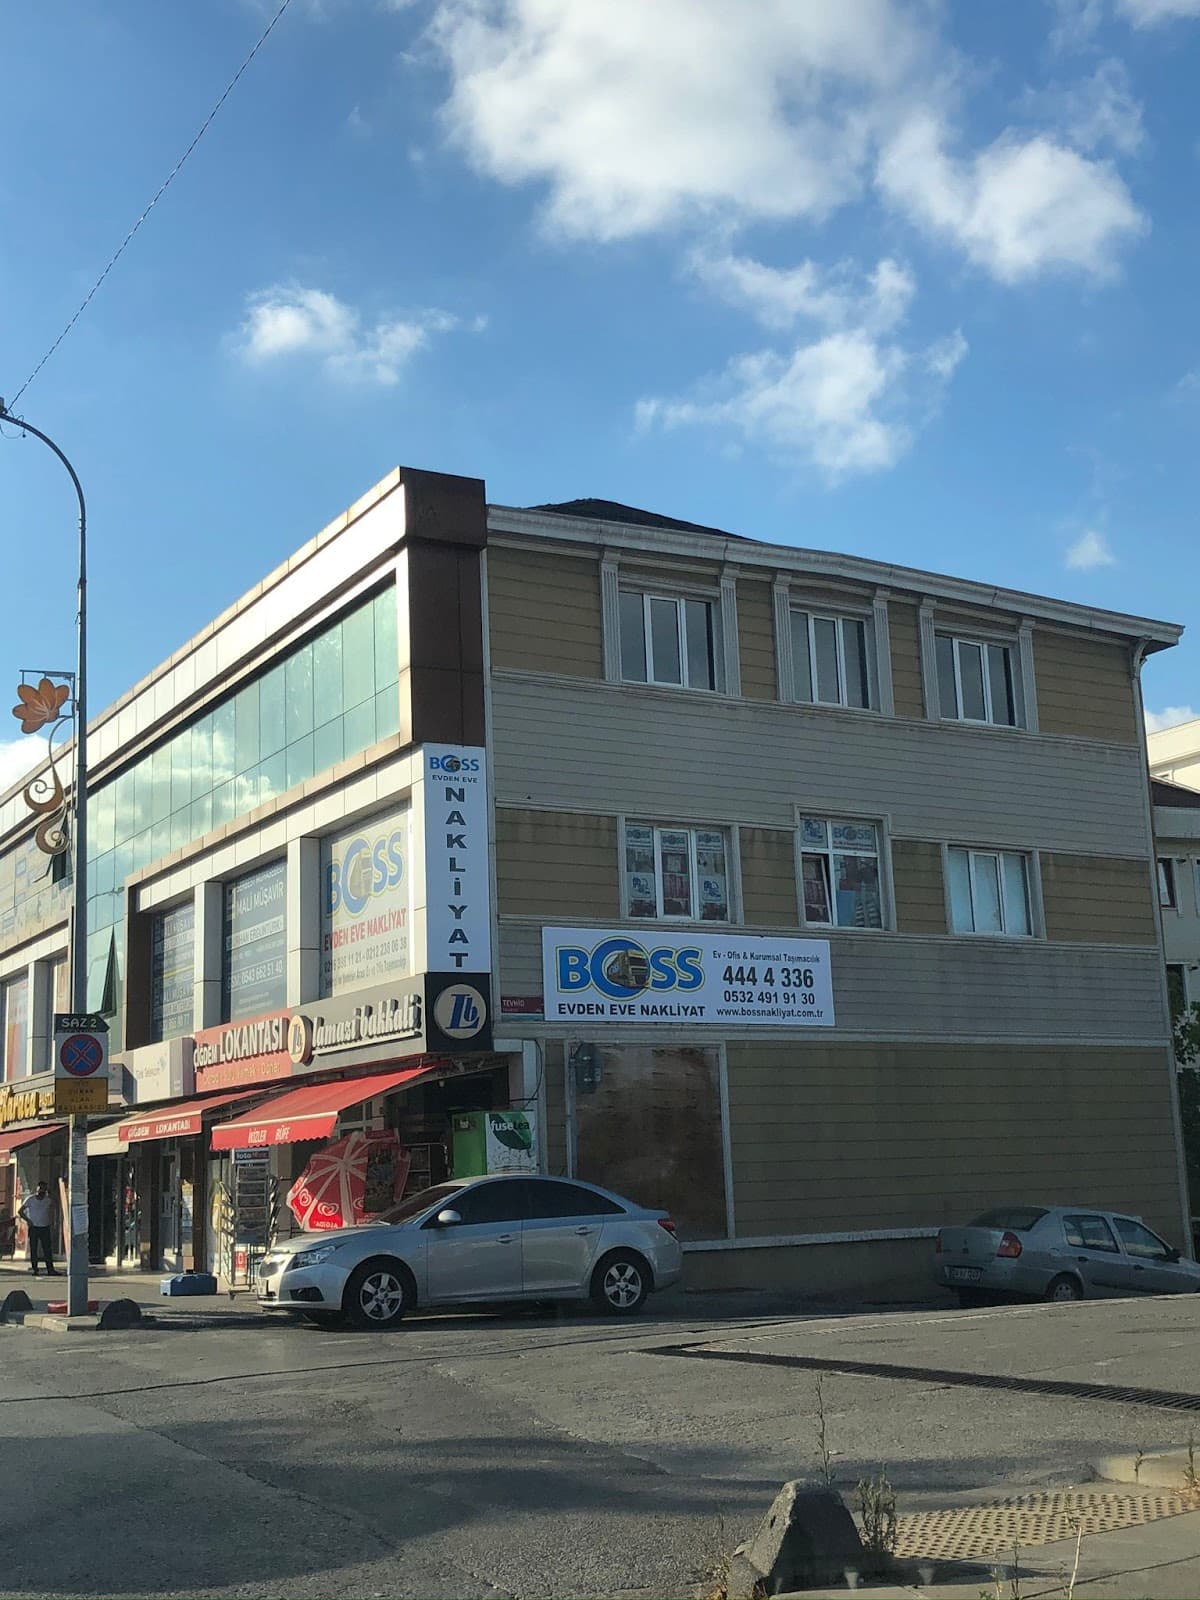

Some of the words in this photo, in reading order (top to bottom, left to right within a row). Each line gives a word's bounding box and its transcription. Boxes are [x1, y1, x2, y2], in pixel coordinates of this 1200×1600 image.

[429, 755, 480, 773] BOSS
[326, 830, 404, 916] BOSS
[445, 786, 470, 968] NAKLİYAT
[324, 927, 348, 952] EVDEN
[350, 921, 366, 943] EVE
[367, 907, 407, 937] NAKLİYAT
[713, 950, 721, 959] Ev
[727, 951, 741, 960] Ofis
[750, 952, 782, 962] Kurumsal
[783, 953, 820, 963] Taşımacılık
[556, 937, 705, 1000] BOSS
[722, 965, 758, 986] 444
[763, 967, 775, 987] 4
[781, 967, 814, 989] 336
[724, 990, 754, 1003] 0532
[758, 991, 778, 1004] 491
[783, 992, 797, 1005] 91
[801, 992, 816, 1005] 30
[558, 1003, 605, 1015] EVDEN
[609, 1004, 636, 1016] EVE
[640, 1002, 706, 1017] NAKLİYAT
[716, 1007, 824, 1019] www.bossnakliyat.com.tr
[61, 1018, 88, 1028] SAZ
[90, 1018, 97, 1028] 2
[220, 1016, 283, 1062] LOKANTASI
